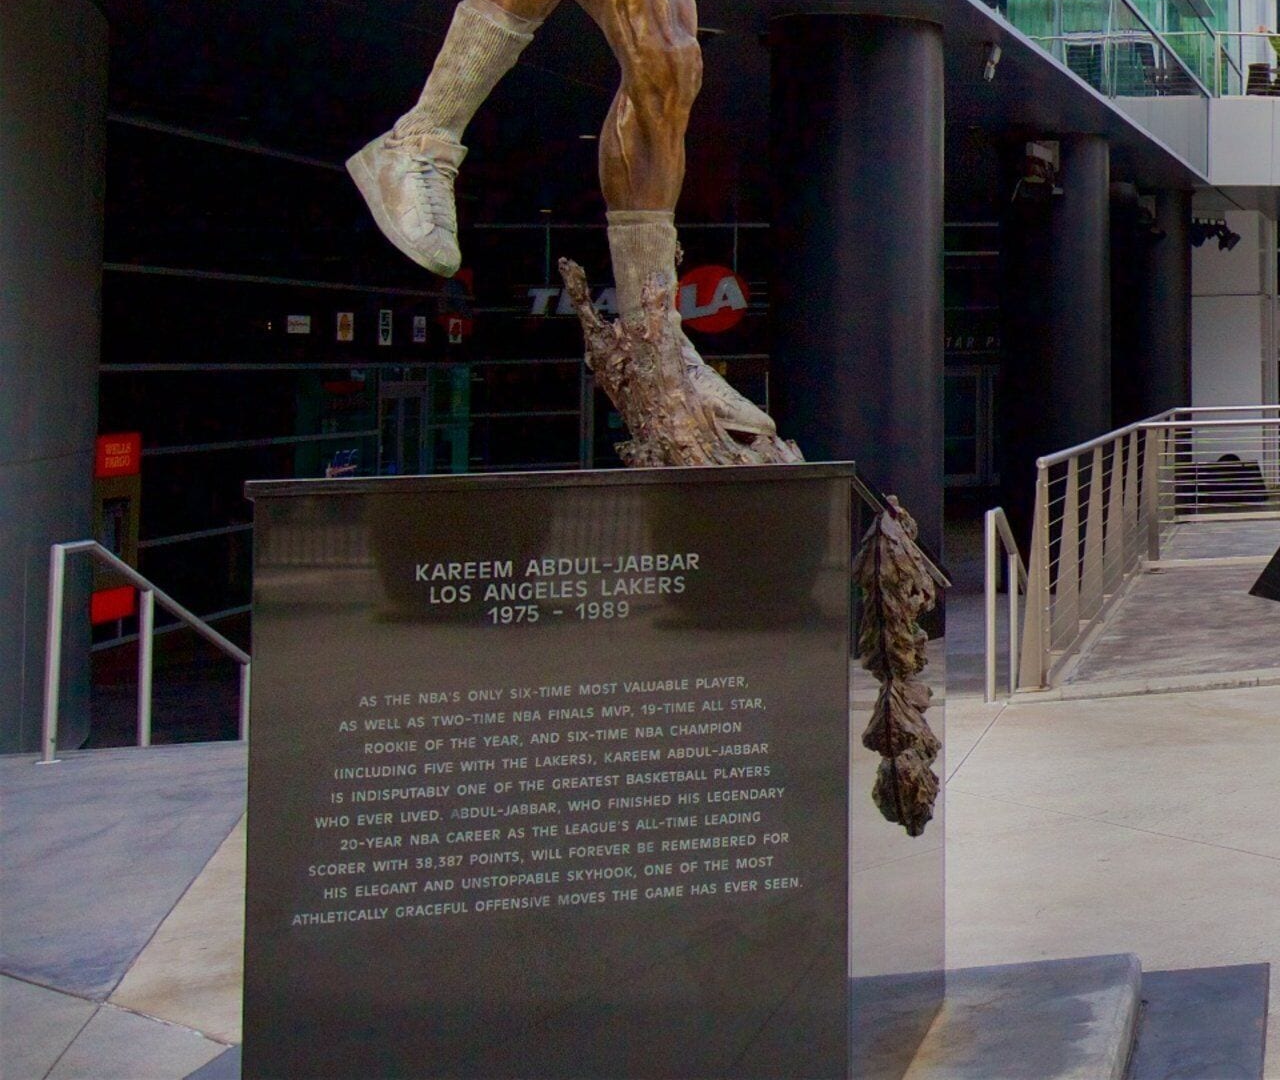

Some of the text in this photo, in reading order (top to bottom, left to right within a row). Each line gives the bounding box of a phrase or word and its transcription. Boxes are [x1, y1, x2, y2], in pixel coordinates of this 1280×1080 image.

[416, 553, 699, 581] KAREEM ABDUL-JABBAR
[429, 576, 685, 604] LOS ANGELES LAKERS
[488, 605, 539, 624] 1975
[575, 601, 629, 620] 1989
[358, 696, 377, 708] AS
[384, 694, 410, 706] THE
[418, 692, 460, 704] NBA'S
[467, 690, 503, 702] ONLY
[509, 686, 571, 700] SIX-TIME
[578, 684, 617, 696] MOST
[623, 680, 689, 694] VALUABLE
[338, 721, 357, 733] AS
[363, 719, 400, 731] WELL
[406, 717, 425, 729] AS
[431, 713, 505, 727] TWO-TIME
[512, 711, 541, 723] NBA
[548, 708, 594, 721] FINALS
[640, 702, 695, 716] 19-TIME
[701, 700, 723, 712] ALL
[363, 740, 417, 755] ROOKIE
[424, 739, 443, 751] OF
[449, 737, 476, 750] THE
[530, 732, 560, 745] AND
[567, 728, 628, 743] SIX-TIME
[634, 726, 663, 739] NBA
[669, 722, 742, 737] CHAMPION
[333, 764, 416, 780] (INCLUDING
[424, 762, 453, 774] FIVE
[460, 760, 495, 772] WITH
[502, 758, 527, 770] THE
[604, 750, 660, 764] KAREEM
[667, 744, 768, 760] ABDUL-JABBAR
[330, 766, 770, 804] IS INDISPUTABLY ONE OF THE GREATEST BASKETBALL PLAYERS
[314, 816, 350, 829] WHO
[357, 813, 393, 826] EVER
[567, 800, 601, 812] WHO
[607, 795, 671, 810] FINISHED
[677, 793, 700, 805] HIS
[706, 788, 785, 803] LEGENDARY
[339, 812, 761, 851] 20-YEAR NBA CAREER AS THE LEAGUE'S ALL-TIME LEADING
[308, 861, 366, 877] SCORER
[372, 858, 408, 872] WITH
[415, 855, 463, 869] 38,387
[530, 848, 562, 861] WILL
[568, 844, 630, 859] FOREVER
[636, 842, 654, 854] BE
[661, 835, 756, 852] REMEMBERED
[762, 833, 789, 845] FOR
[324, 886, 346, 900] HIS
[355, 881, 418, 897] ELEGANT
[424, 879, 453, 892] AND
[462, 871, 560, 889] UNSTOPPABLE
[643, 863, 673, 876] ONE
[680, 861, 698, 873] OF
[704, 859, 729, 872] THE
[736, 856, 774, 869] MOST
[291, 908, 388, 926] ATHLETICALLY
[394, 902, 468, 918] GRACEFUL
[474, 896, 550, 912] OFFENSIVE
[557, 892, 606, 906] MOVES
[612, 890, 637, 902] THE
[644, 887, 683, 900] GAME
[690, 884, 717, 897] HAS
[724, 881, 758, 894] EVER
